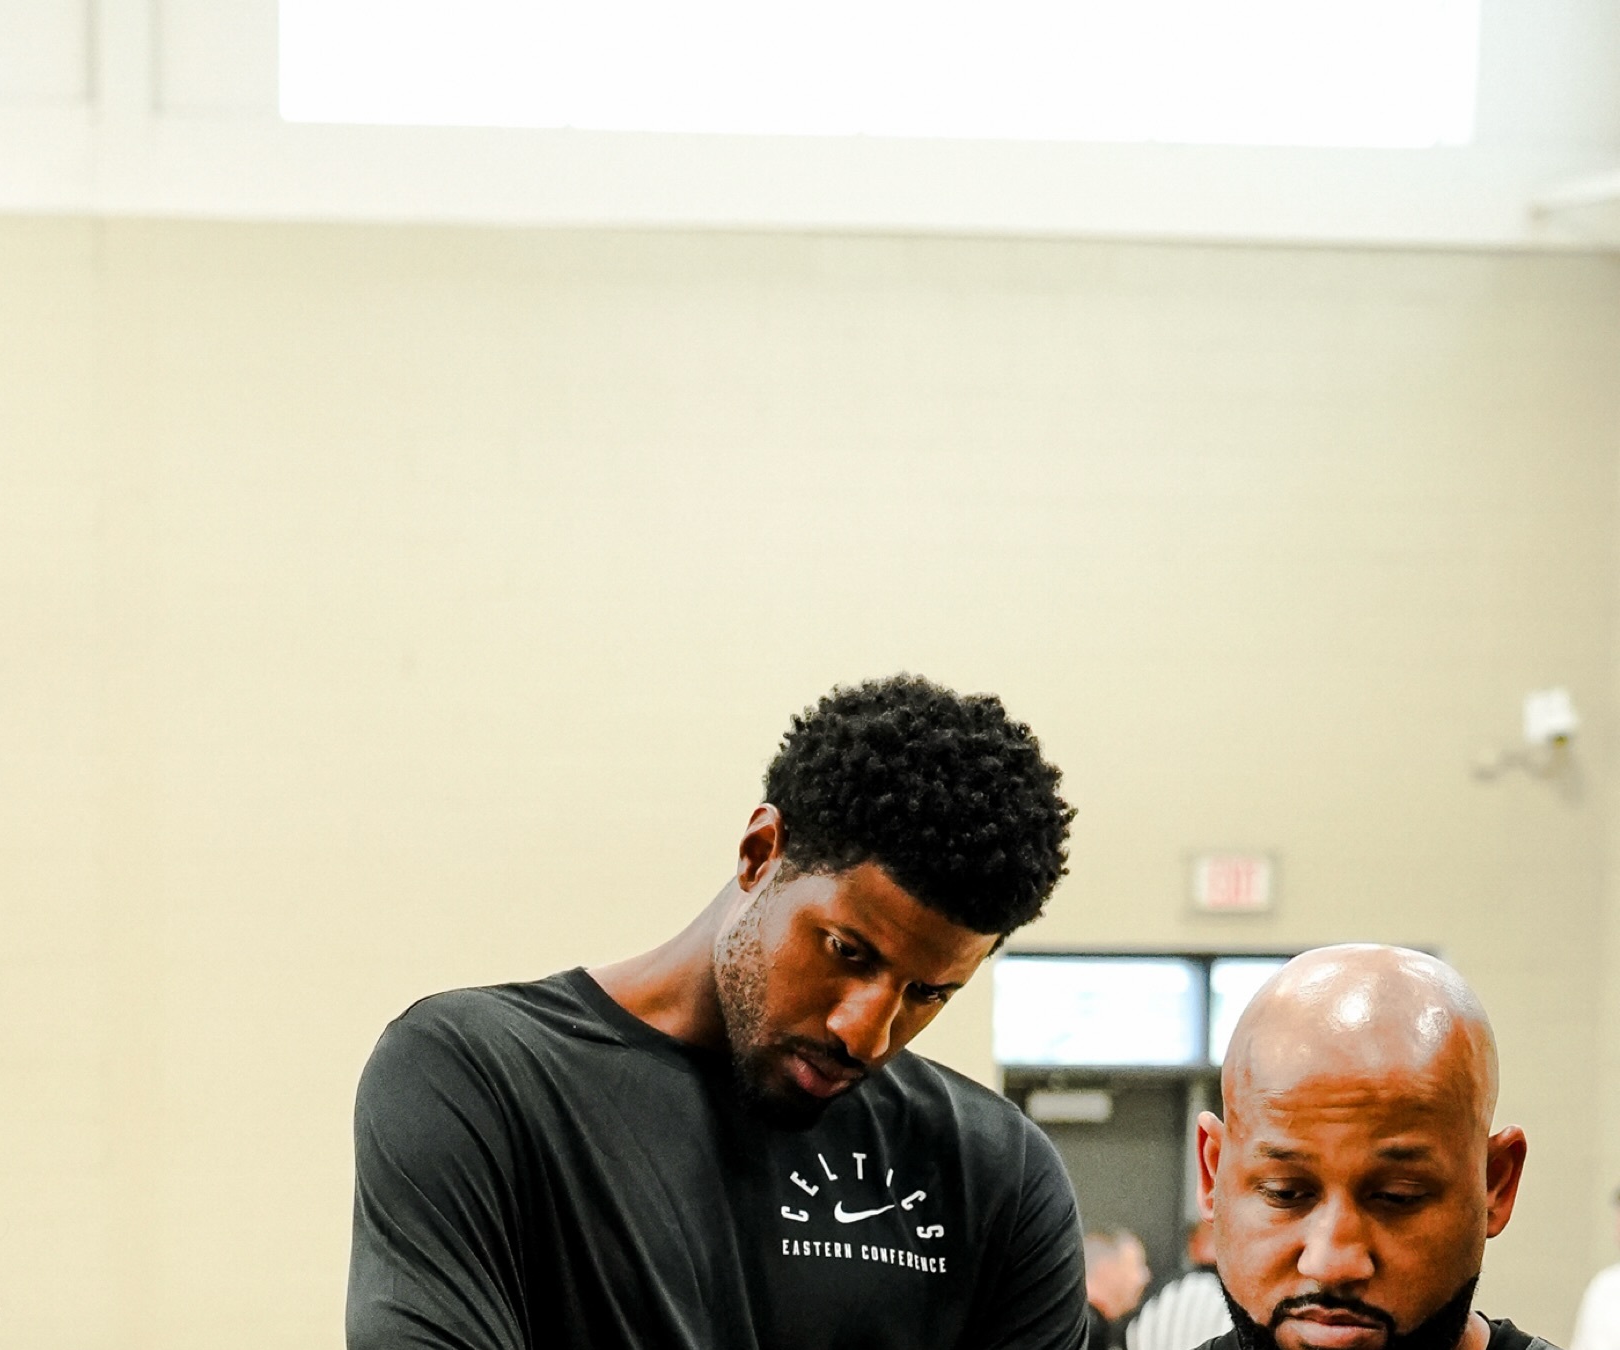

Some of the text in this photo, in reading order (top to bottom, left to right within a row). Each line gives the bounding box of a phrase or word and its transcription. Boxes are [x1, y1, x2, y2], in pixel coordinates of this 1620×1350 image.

[780, 1152, 945, 1240] CELTICS
[782, 1239, 947, 1274] EASTERN CONFERENCE
